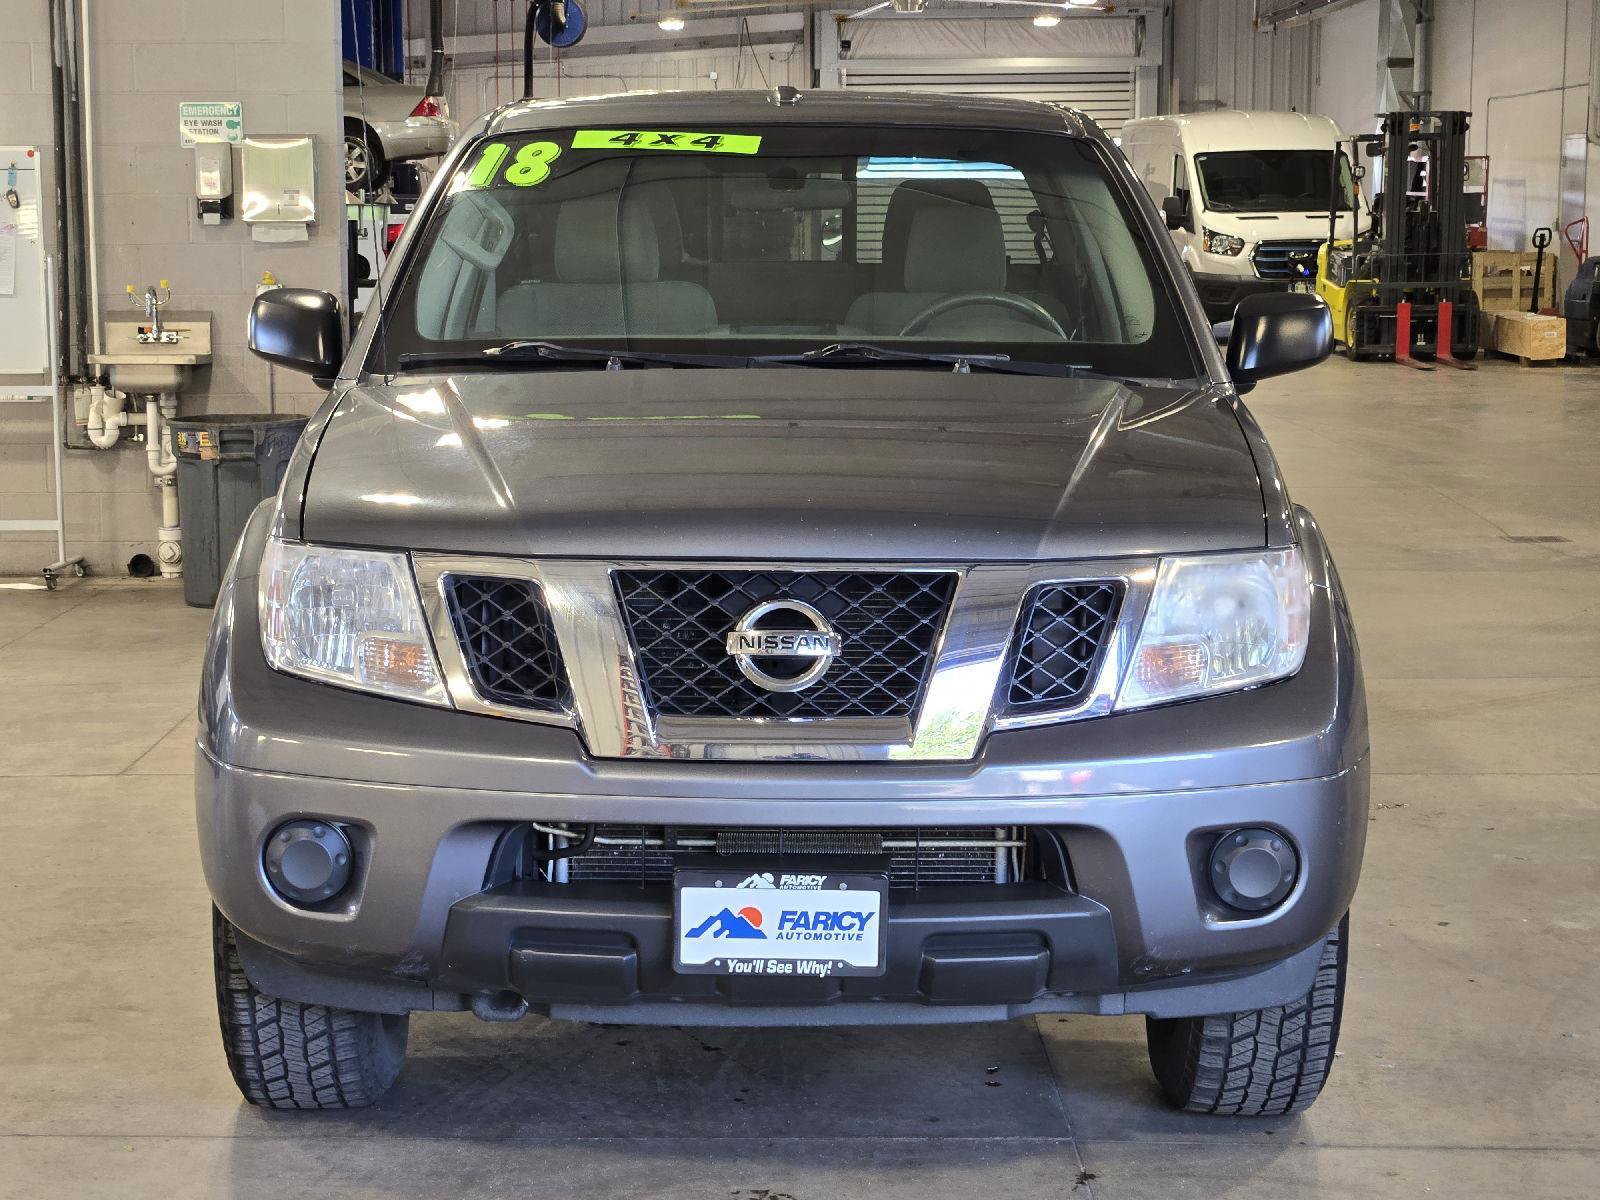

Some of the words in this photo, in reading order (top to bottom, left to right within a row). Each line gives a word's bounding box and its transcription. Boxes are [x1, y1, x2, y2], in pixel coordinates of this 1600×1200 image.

[182, 105, 238, 116] EMERGENCY
[469, 141, 562, 187] 18
[739, 635, 829, 650] NISSAN
[780, 875, 827, 885] FARICY
[778, 911, 875, 931] FARICY
[776, 932, 864, 941] AUTOMOTIVE
[728, 959, 764, 973] You'll
[767, 961, 793, 974] See
[796, 961, 832, 977] Why!
